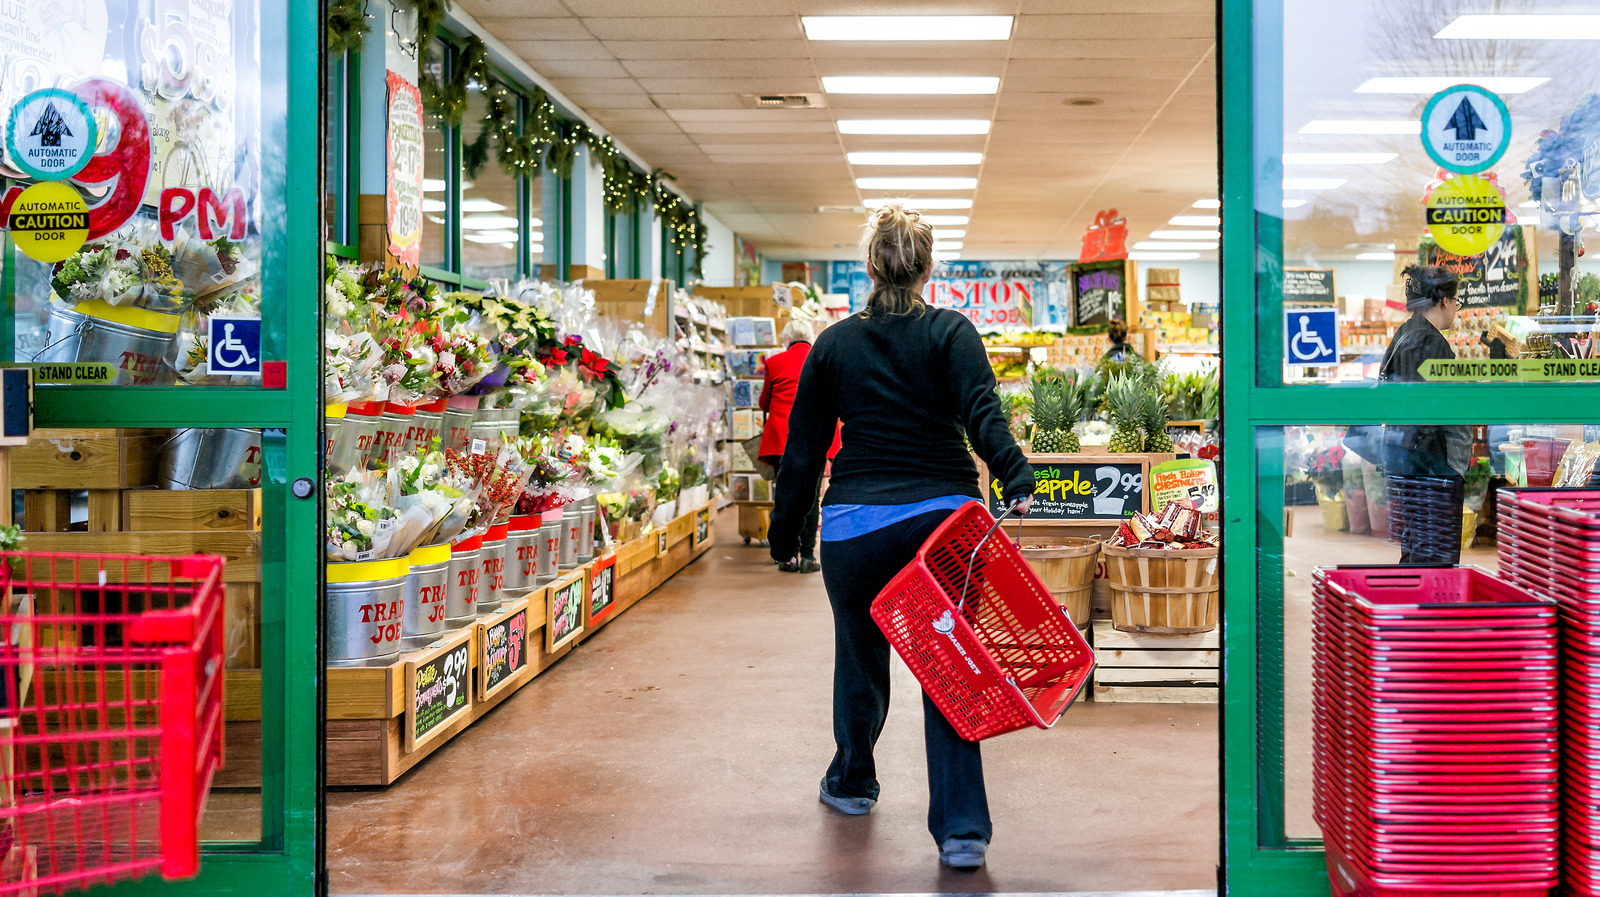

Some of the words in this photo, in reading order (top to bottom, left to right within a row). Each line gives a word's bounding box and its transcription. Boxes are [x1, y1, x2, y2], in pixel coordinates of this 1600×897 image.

[1443, 142, 1492, 151] AUTOMATIC
[28, 148, 77, 158] AUTOMATIC
[1455, 152, 1481, 161] DOOR
[41, 158, 65, 168] DOOR
[1436, 195, 1498, 205] AUTOMATIC
[19, 201, 81, 211] AUTOMATIC
[158, 187, 249, 243] PM
[1431, 209, 1502, 223] CAUTION
[15, 214, 85, 228] CAUTION
[1451, 226, 1482, 235] DOOR
[34, 231, 65, 241] DOOR
[928, 281, 1035, 308] ESTON
[985, 309, 1022, 324] JOE
[39, 367, 72, 379] STAND
[75, 367, 107, 379] CLEAR
[1429, 363, 1487, 376] AUTOMATIC
[1491, 363, 1517, 376] DOOR
[1543, 363, 1576, 376] STAND
[1579, 363, 1600, 376] CLEA
[1034, 465, 1061, 479] esh
[1155, 472, 1177, 482] Fresh
[1060, 501, 1089, 510] pineapple
